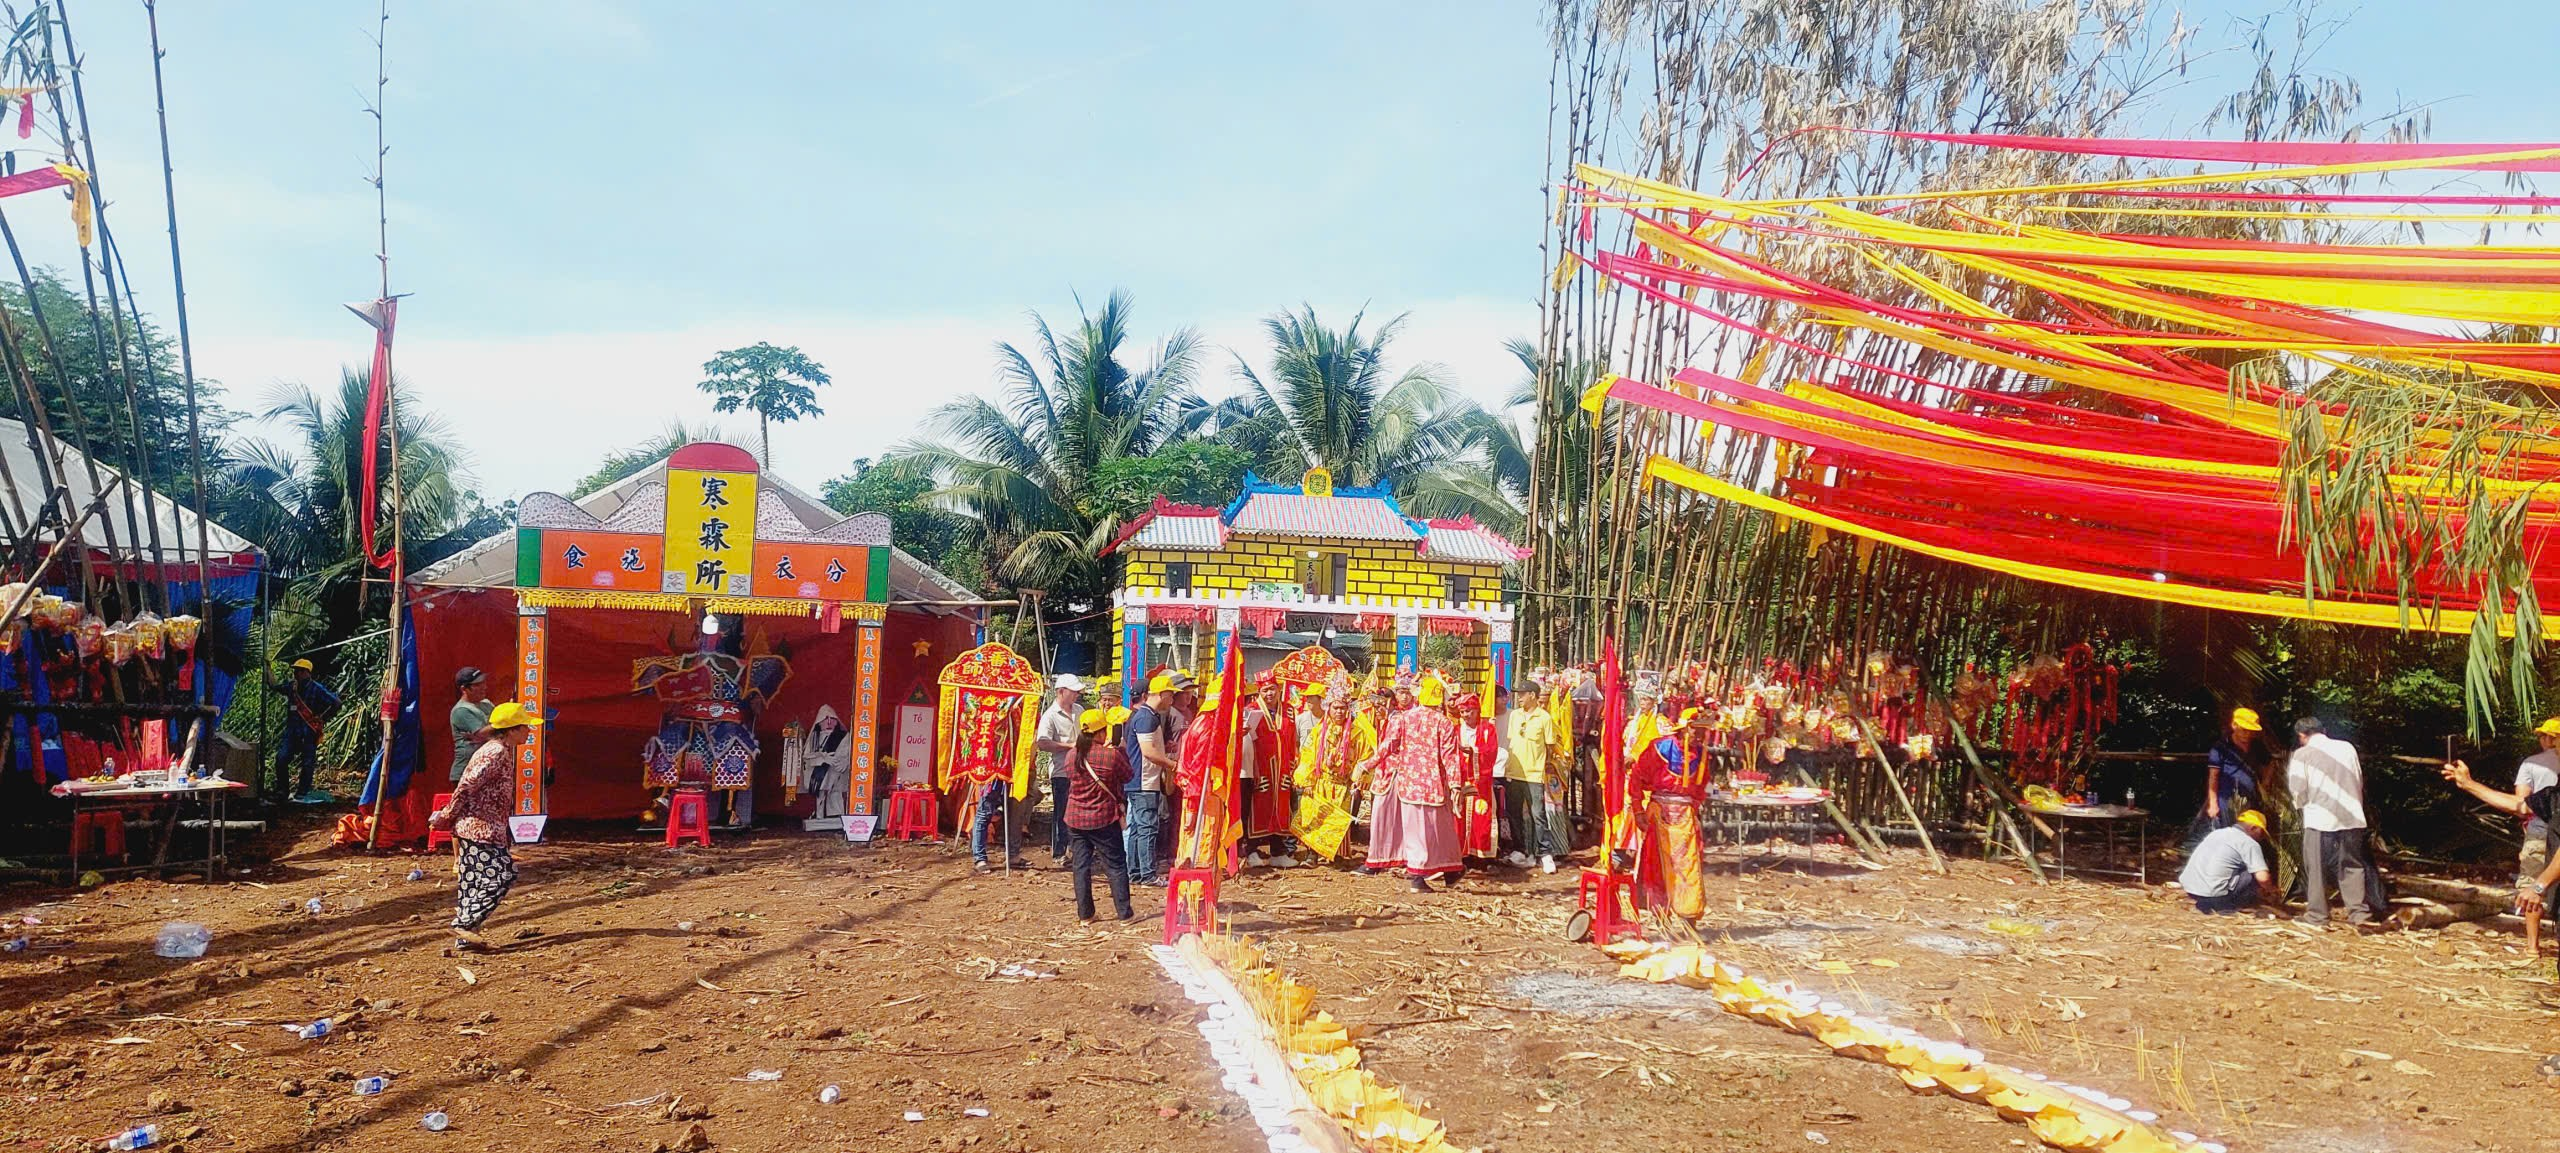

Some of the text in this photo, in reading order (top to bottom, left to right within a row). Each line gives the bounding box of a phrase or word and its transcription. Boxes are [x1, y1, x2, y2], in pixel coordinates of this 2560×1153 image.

[695, 476, 731, 592] 寒霖所
[906, 734, 927, 745] Quốc
[906, 758, 921, 768] Ghi
